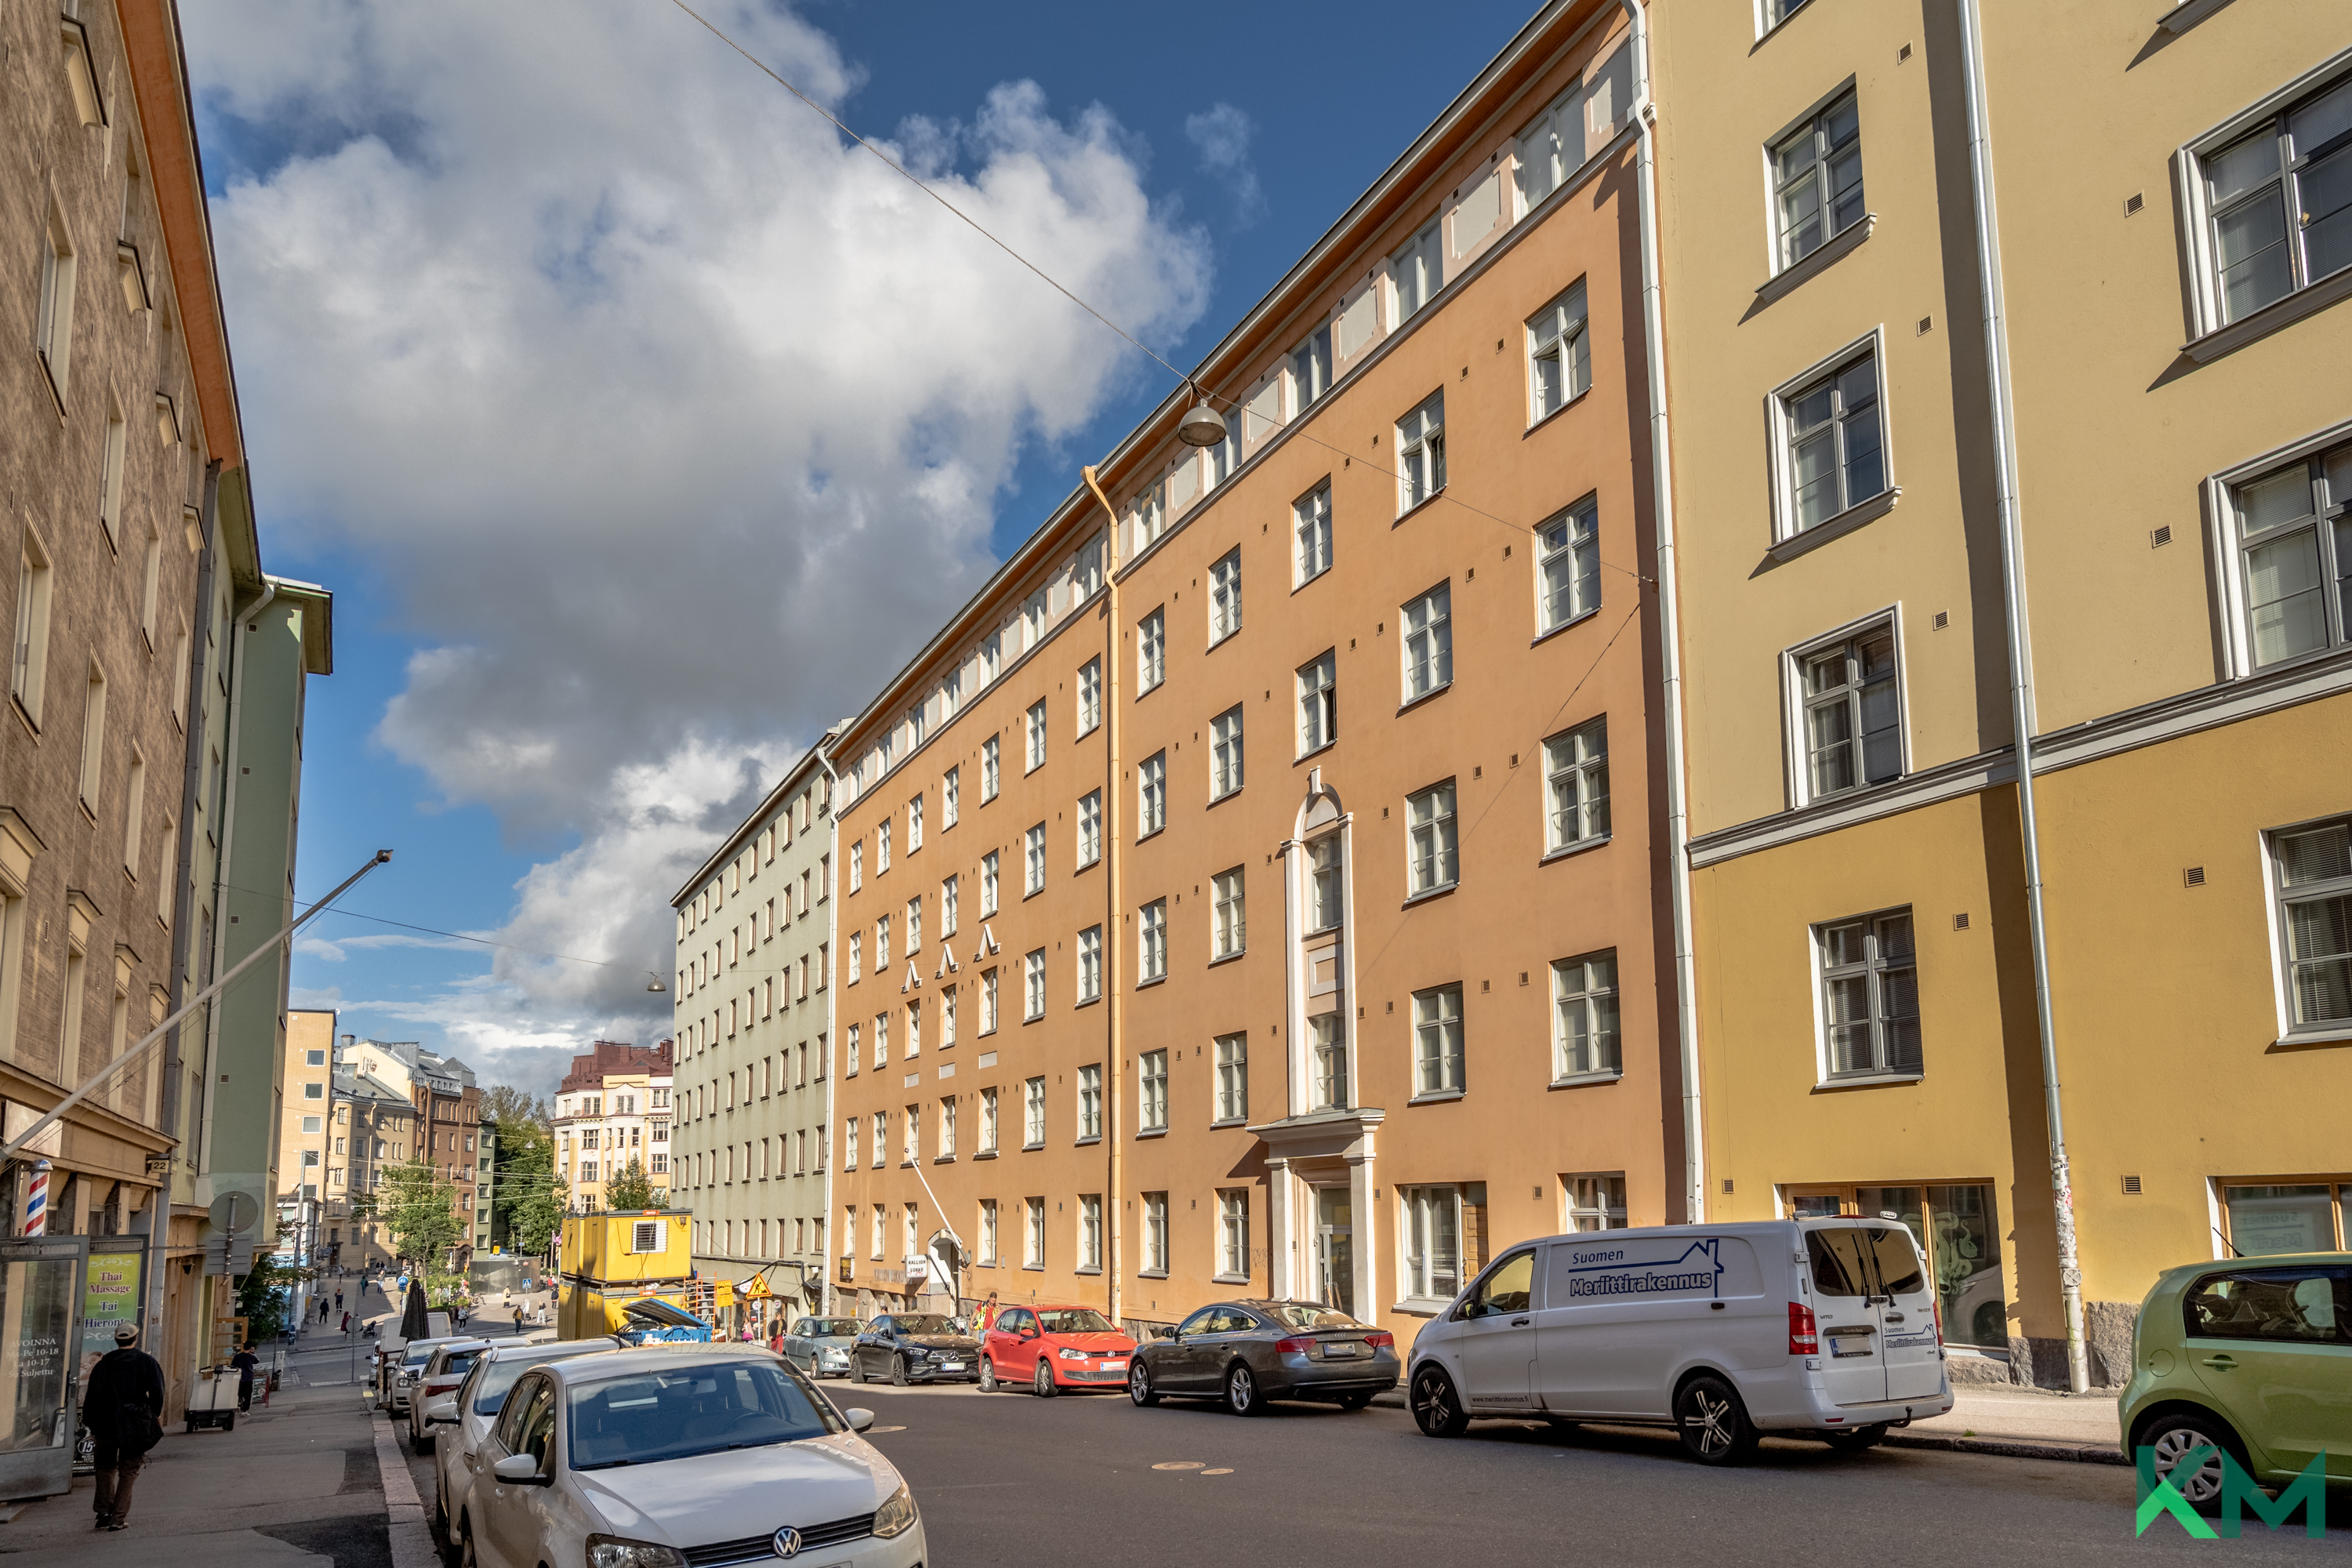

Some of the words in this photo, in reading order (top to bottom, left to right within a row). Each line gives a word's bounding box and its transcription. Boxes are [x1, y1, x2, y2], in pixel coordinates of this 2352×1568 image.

[1573, 1250, 1624, 1265] Suomen
[100, 1271, 122, 1281] Thai
[89, 1284, 131, 1294] Massage
[1570, 1272, 1712, 1297] Meriittirakennus
[100, 1301, 118, 1311] Tai
[84, 1317, 130, 1328] Hieront
[11, 1338, 56, 1348] AVOINNA
[1886, 1338, 1933, 1348] Meriittirakennus
[36, 1348, 59, 1356] 10-18
[27, 1358, 50, 1367] 10-17
[21, 1368, 53, 1378] Suljettu
